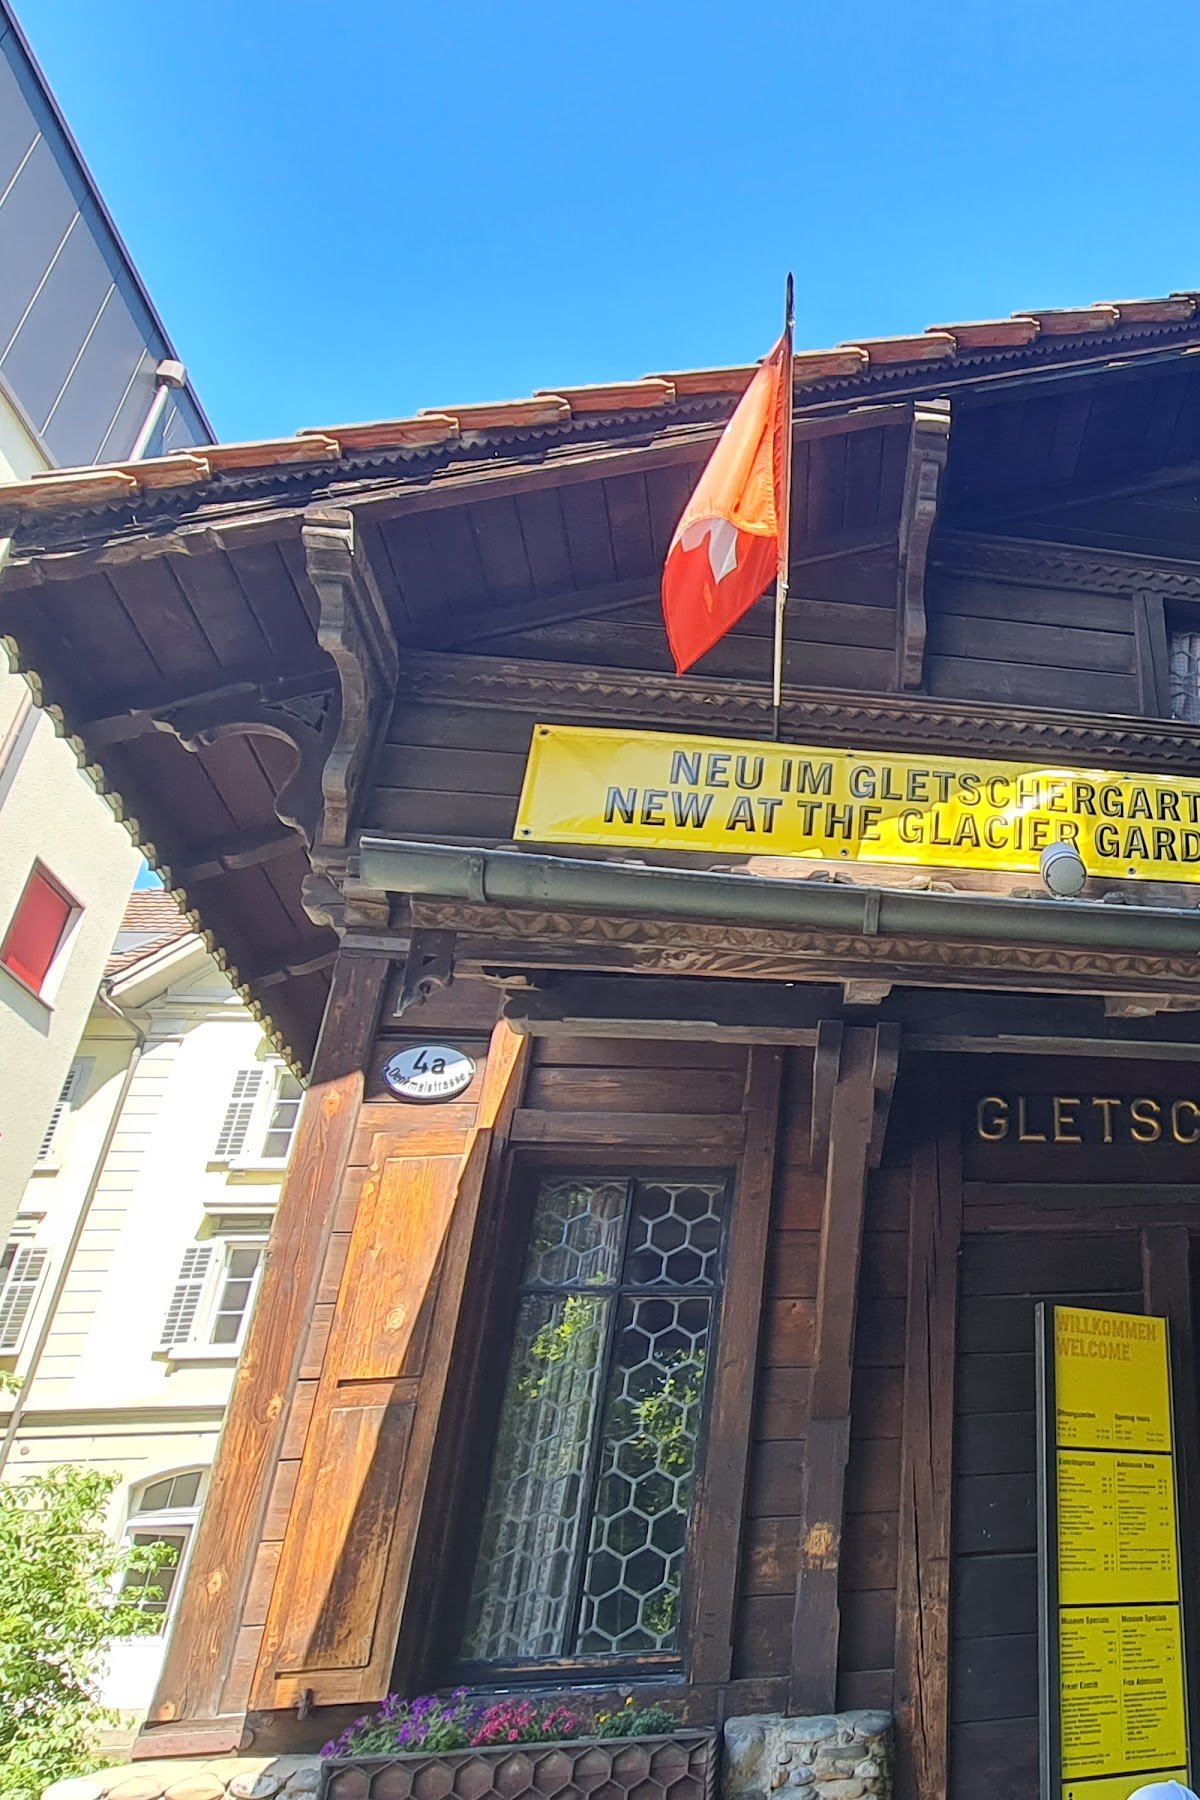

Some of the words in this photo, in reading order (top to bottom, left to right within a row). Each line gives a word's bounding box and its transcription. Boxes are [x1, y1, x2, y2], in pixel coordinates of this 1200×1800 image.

[669, 750, 764, 790] NEU
[780, 759, 833, 796] IM
[603, 786, 714, 829] NEW
[725, 796, 783, 834] AT
[797, 800, 882, 841] THE
[897, 808, 1080, 855] GLACIER
[412, 1049, 446, 1075] 4a
[387, 1066, 466, 1093] Denkmalstrasse
[1056, 1313, 1157, 1342] WILLKOMMEN
[1056, 1335, 1132, 1362] WELCOME
